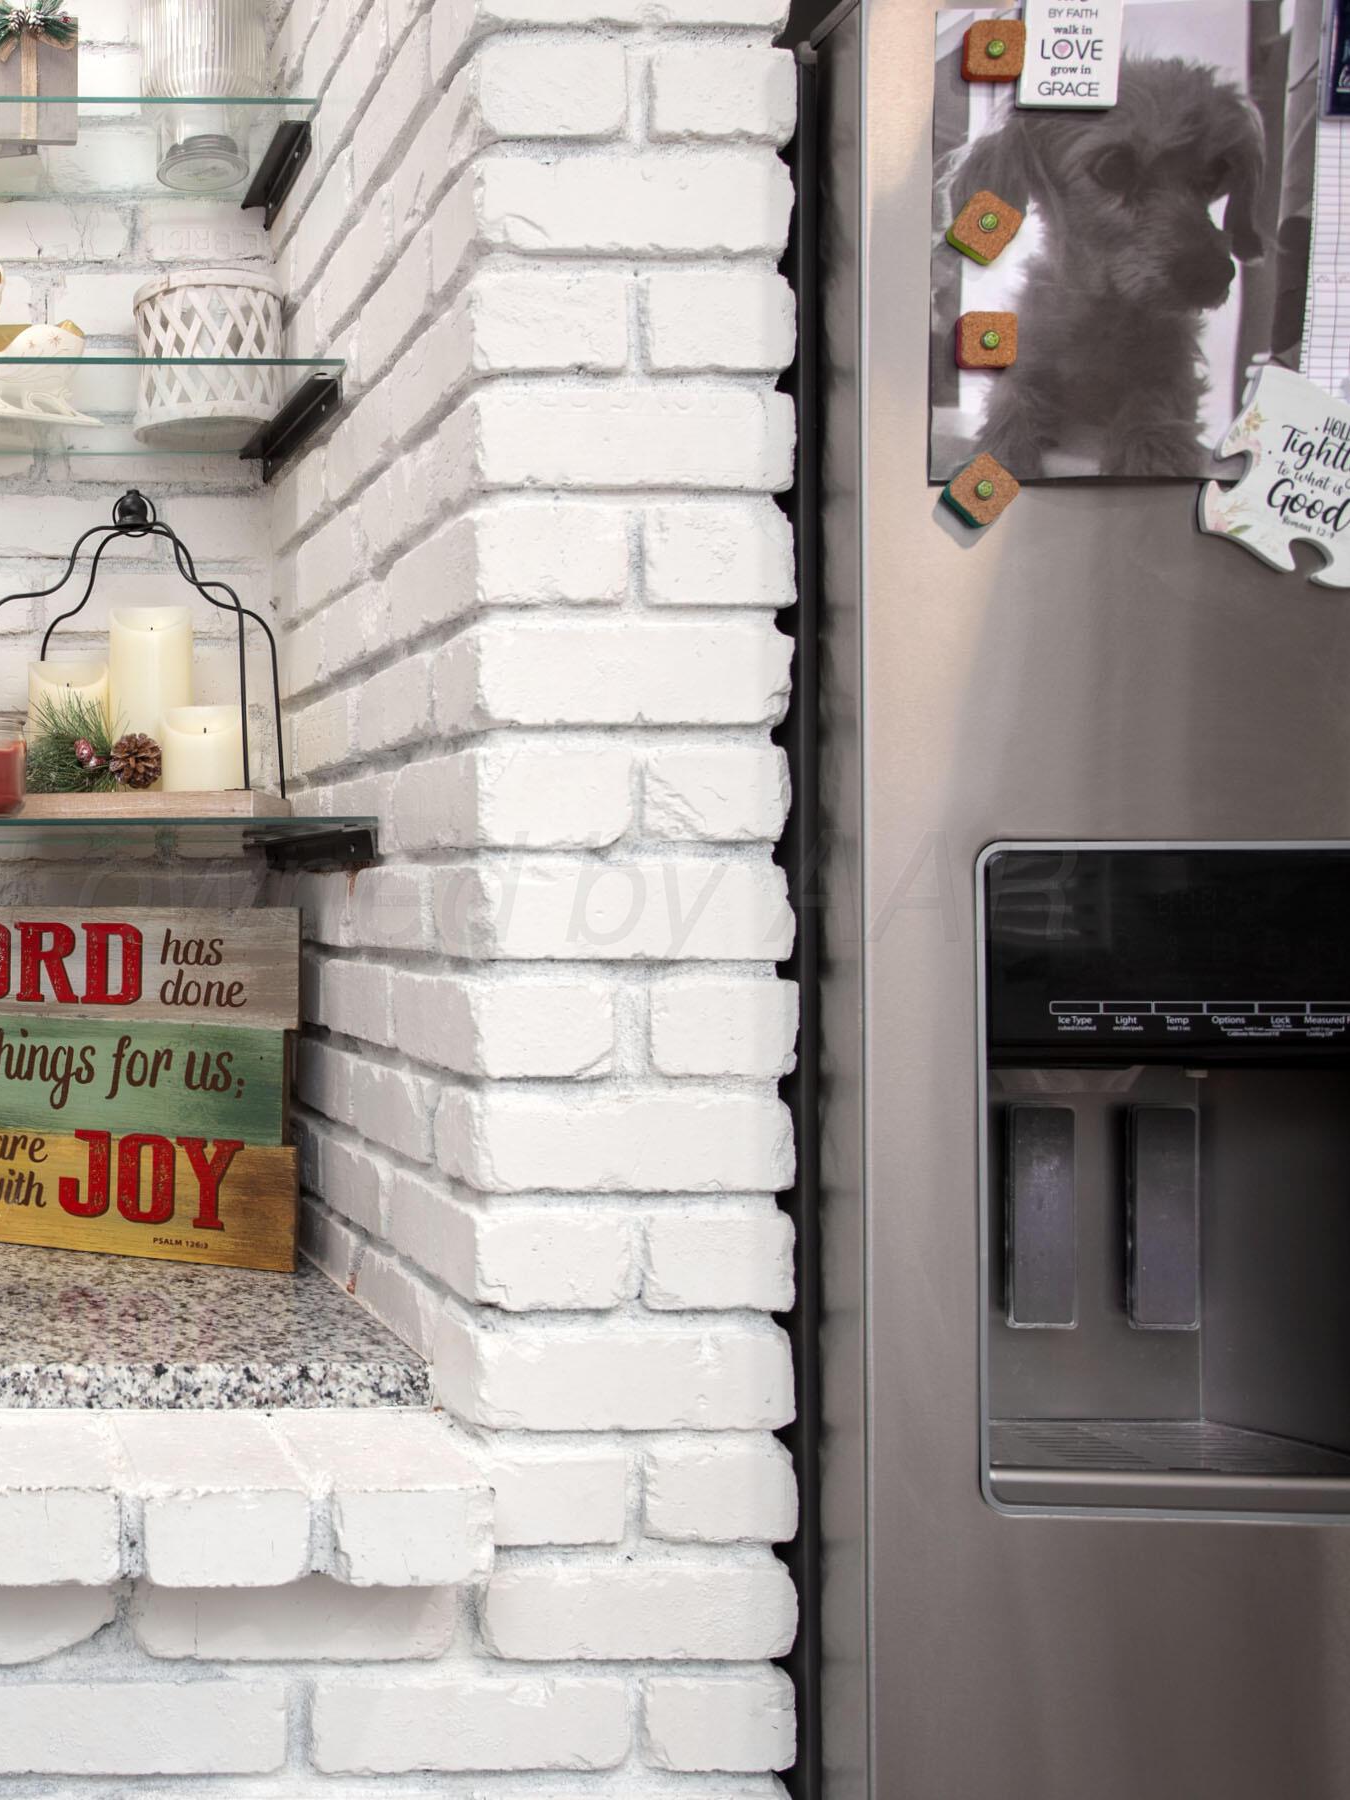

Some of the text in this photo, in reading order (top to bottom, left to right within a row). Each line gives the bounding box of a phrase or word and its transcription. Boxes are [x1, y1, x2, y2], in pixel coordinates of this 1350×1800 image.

[1048, 8, 1098, 19] BY FAITH
[1053, 25, 1093, 35] walk in
[1040, 39, 1104, 61] LOVE
[1050, 65, 1092, 76] grow in
[1037, 81, 1100, 97] GRACE
[1323, 416, 1350, 441] HOL
[1276, 461, 1344, 496] to what is
[1267, 478, 1350, 533] Good
[159, 928, 224, 966] has
[159, 968, 248, 1008] done
[1058, 1016, 1093, 1026] Ice Type
[1115, 1016, 1138, 1026] Light
[1165, 1016, 1190, 1025] Temp
[1211, 1016, 1246, 1025] Options
[1270, 1016, 1291, 1025] Lock
[1304, 1016, 1345, 1025] Measured
[104, 1034, 173, 1100] for
[184, 1049, 246, 1099] us;
[58, 1128, 246, 1231] JOY
[153, 1237, 183, 1247] PSALM
